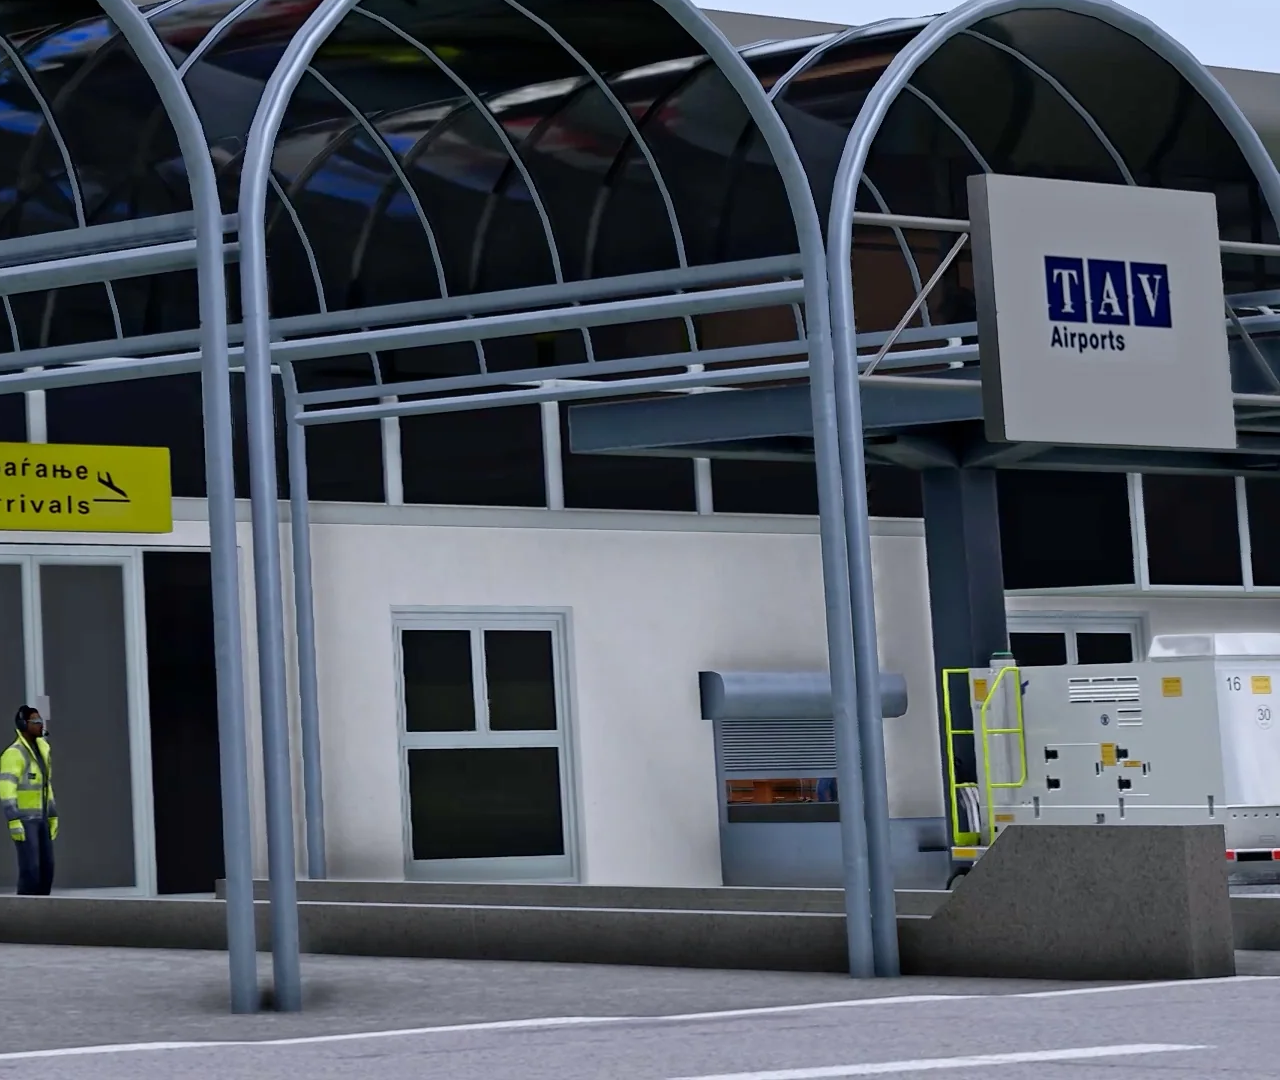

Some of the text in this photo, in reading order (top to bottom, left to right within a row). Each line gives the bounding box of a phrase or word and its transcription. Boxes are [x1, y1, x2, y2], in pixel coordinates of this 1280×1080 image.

[1052, 268, 1163, 318] TAV
[1050, 325, 1126, 354] Airports
[1226, 676, 1241, 691] 16
[1257, 708, 1271, 721] 30
